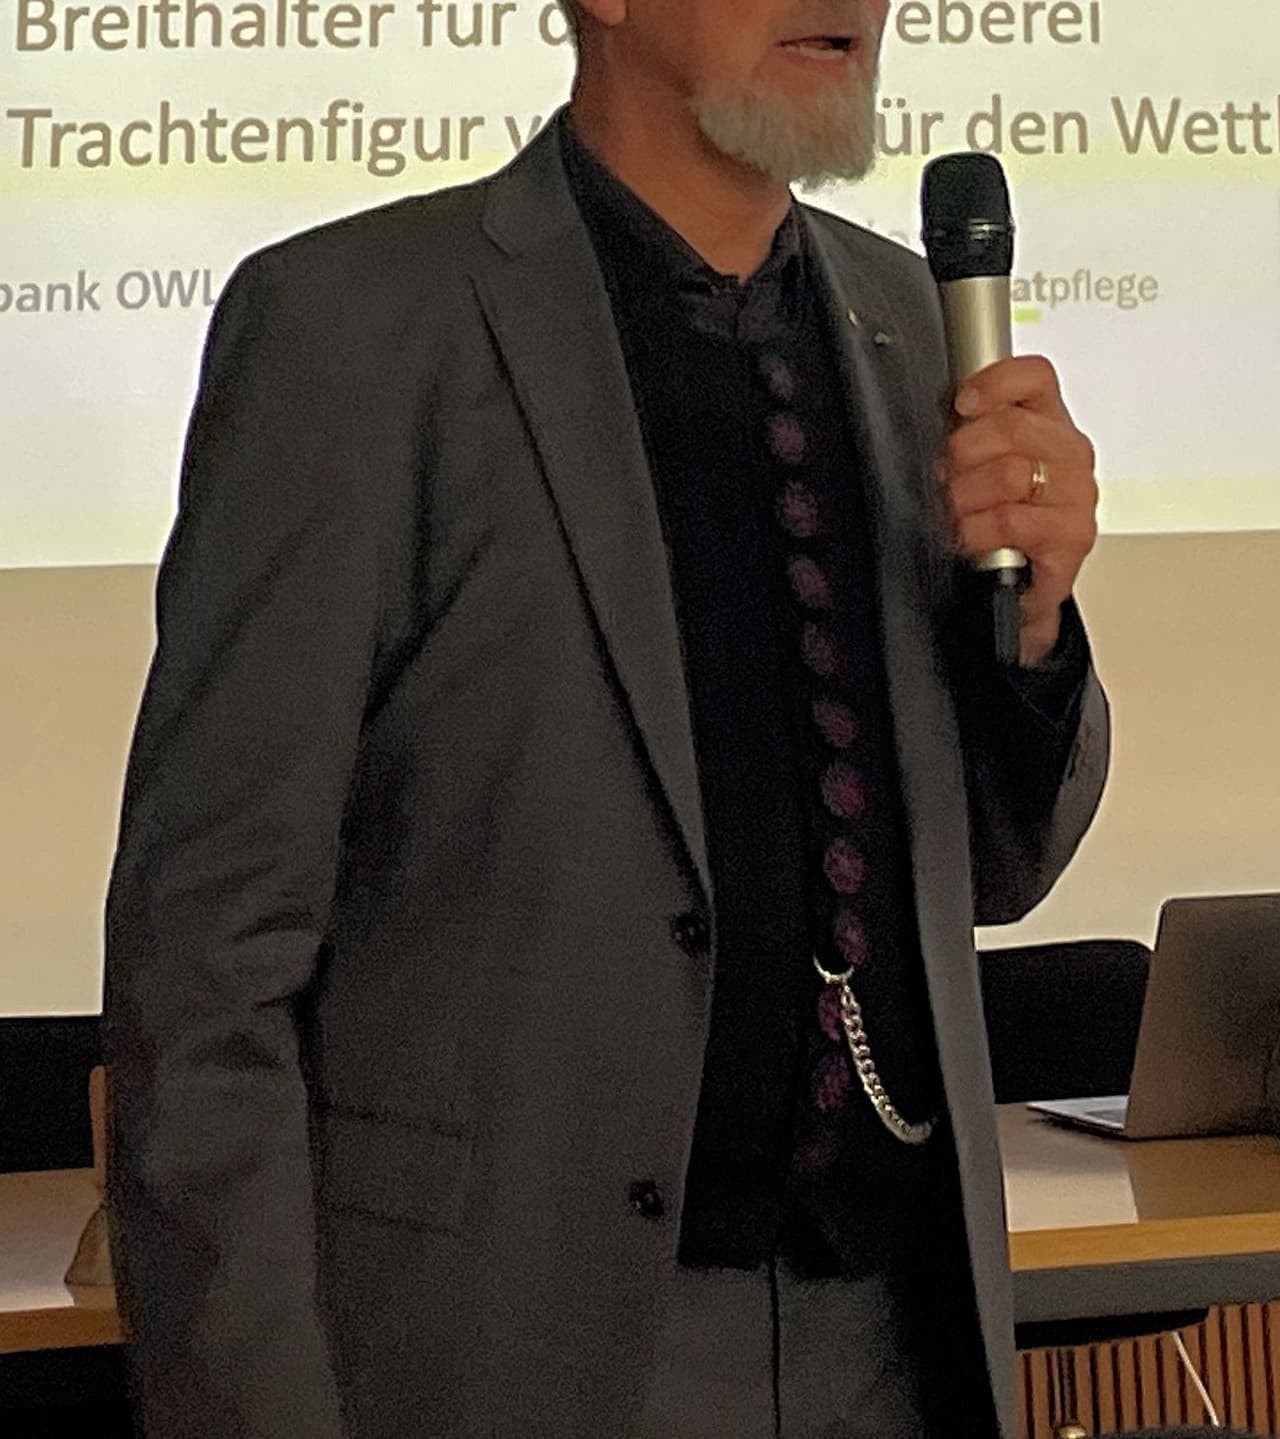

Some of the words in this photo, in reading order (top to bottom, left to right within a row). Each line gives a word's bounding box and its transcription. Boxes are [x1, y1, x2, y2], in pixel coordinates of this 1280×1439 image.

[6, 99, 485, 178] Trachtenfigur
[876, 97, 945, 155] ür
[965, 93, 1088, 155] den
[116, 268, 215, 310] OWL
[1010, 268, 1159, 311] atpflege
